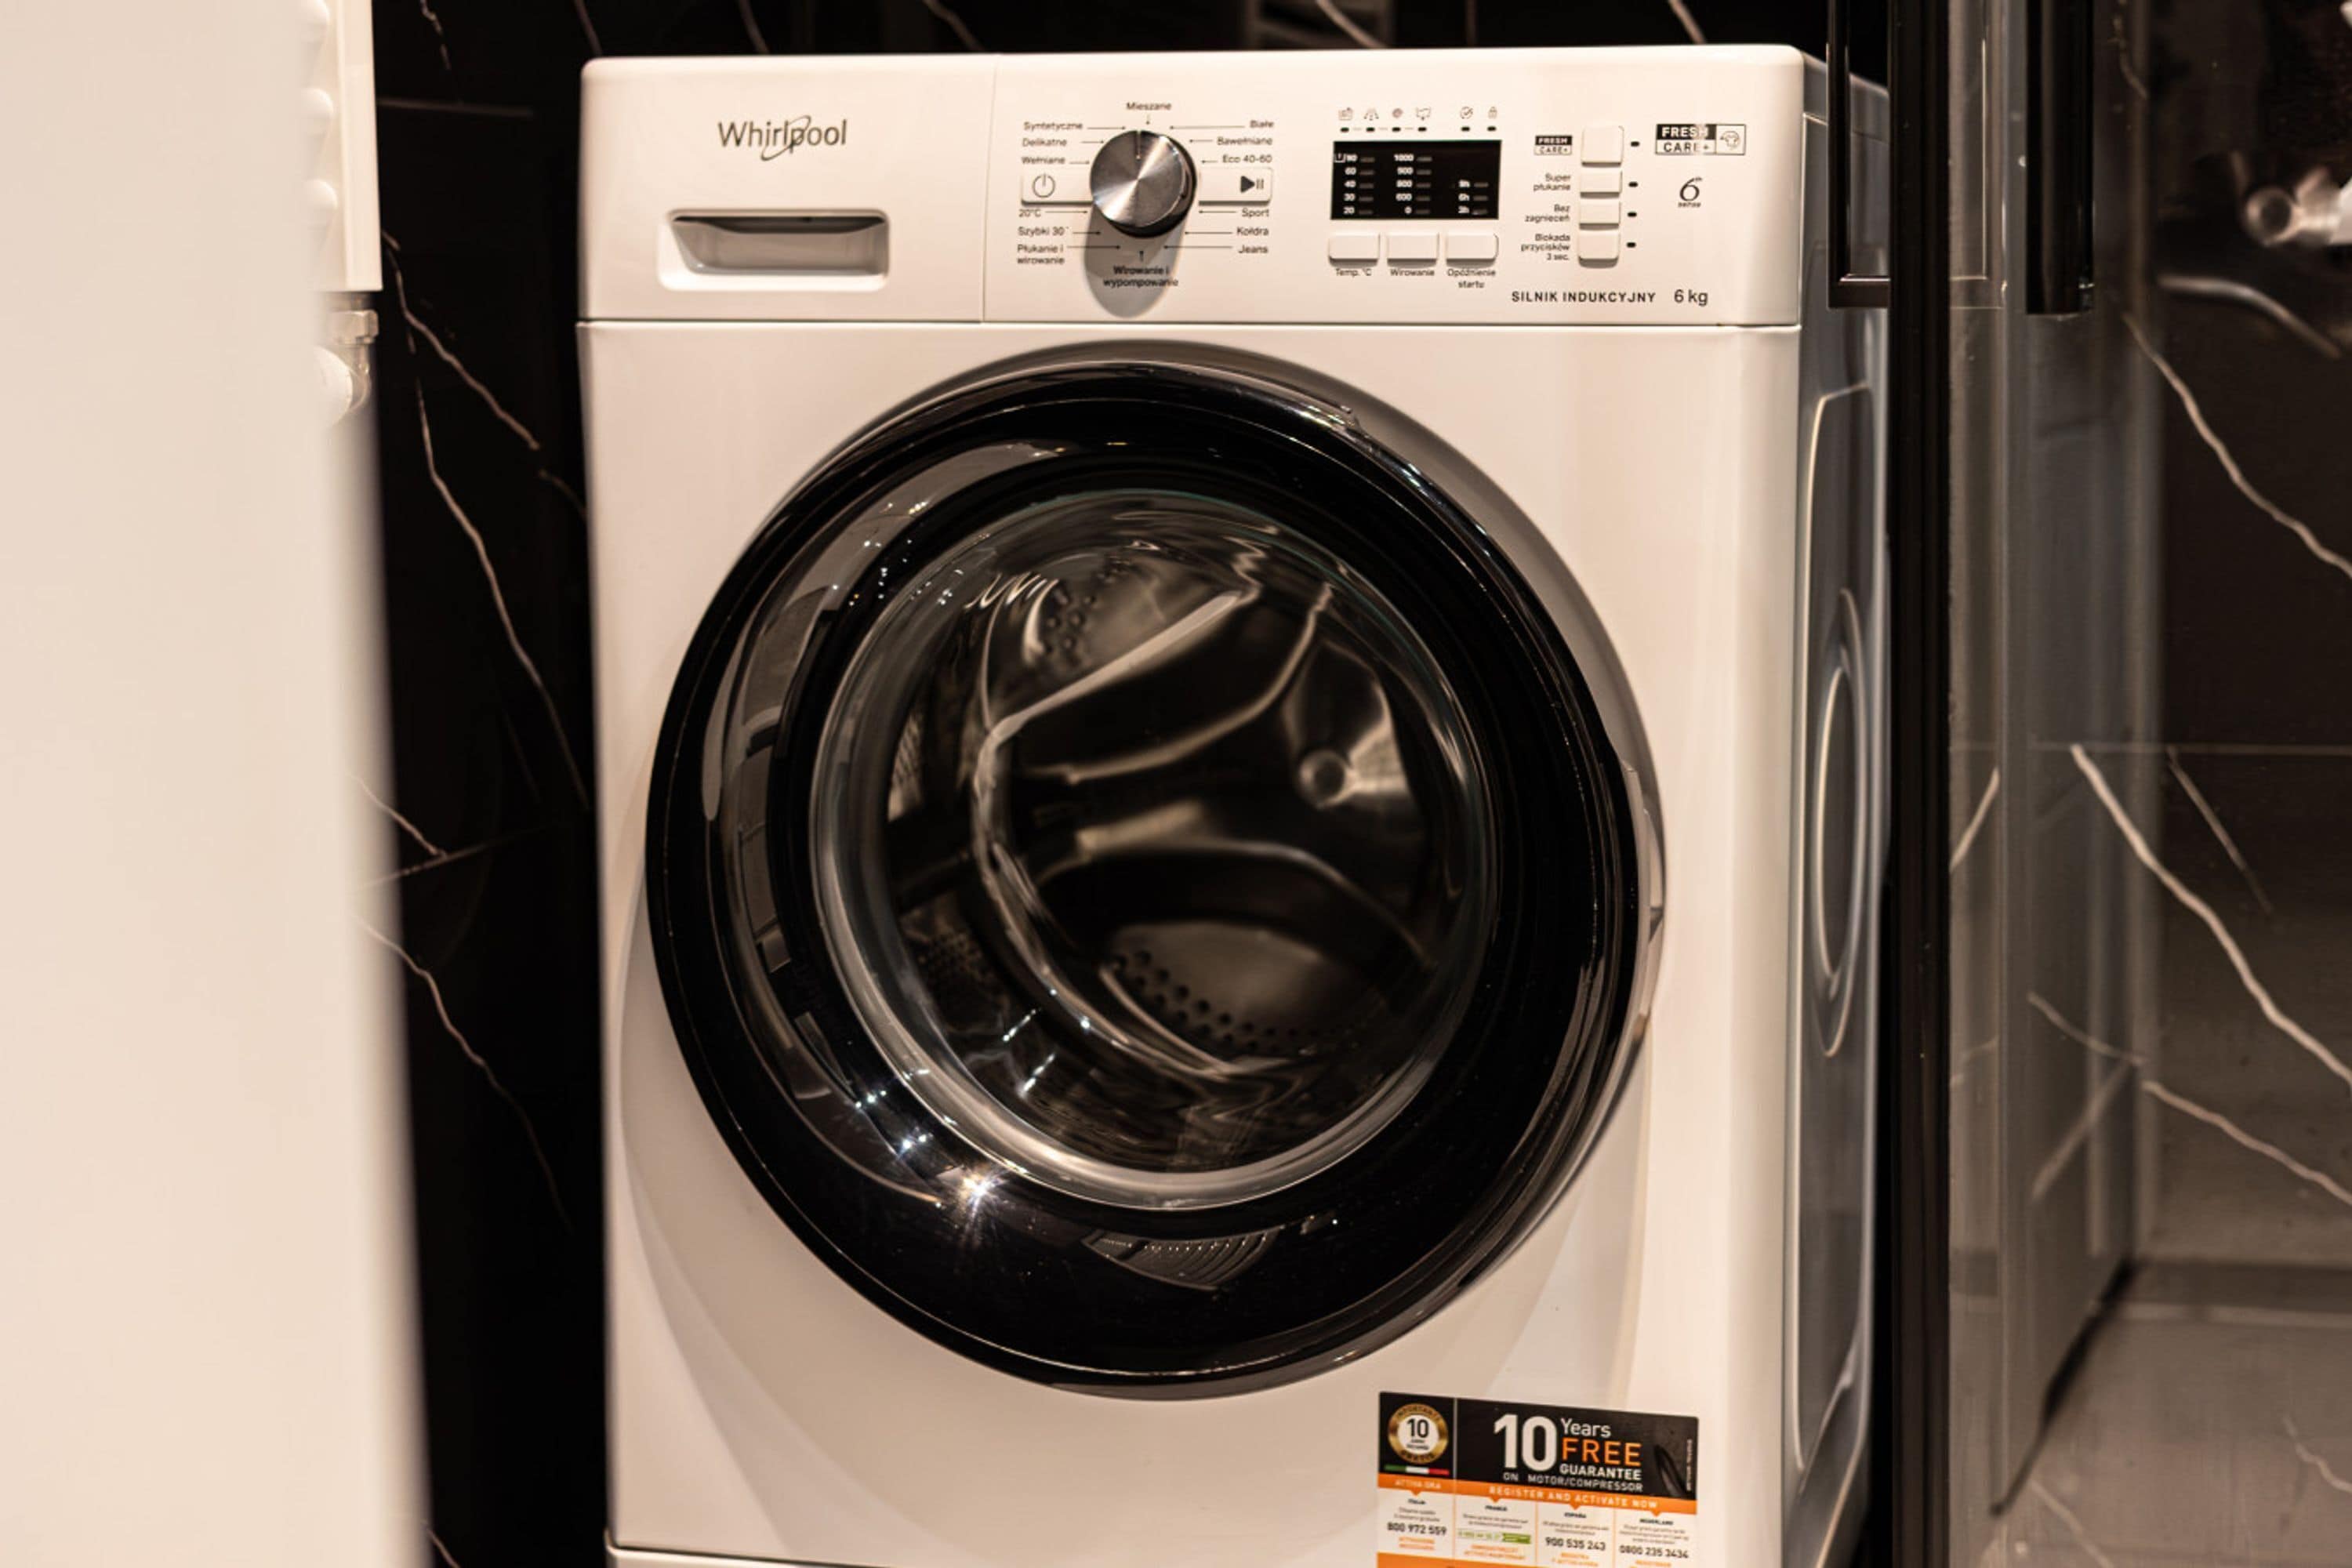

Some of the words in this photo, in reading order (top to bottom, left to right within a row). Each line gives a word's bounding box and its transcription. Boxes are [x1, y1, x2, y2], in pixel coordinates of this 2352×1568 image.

[1127, 101, 1171, 111] Mieszane
[1024, 122, 1083, 132] Syntetyczne
[1661, 125, 1709, 138] FRESH
[718, 115, 848, 162] Whirlpool
[1022, 137, 1067, 147] Delikatne
[1538, 137, 1569, 146] FRESH
[1222, 154, 1240, 163] Eco
[1243, 154, 1272, 163] 40-60
[1544, 173, 1571, 183] Super
[1242, 208, 1269, 219] Sport
[1018, 226, 1049, 237] Szybki
[1239, 245, 1269, 254] Jeans
[1018, 256, 1065, 264] wirowanie
[1113, 265, 1164, 275] Wirowanie
[1103, 278, 1178, 289] wypompowanie
[1512, 292, 1557, 303] SILNIK
[1563, 292, 1656, 303] INDUKCYJNY
[1674, 291, 1684, 303] 6
[1688, 289, 1708, 306] kg
[1407, 1418, 1429, 1438] 10
[1560, 1417, 1612, 1439] Years
[1494, 1414, 1558, 1472] 10
[1561, 1437, 1642, 1467] FREE
[1559, 1463, 1642, 1481] GUARANTEE
[1503, 1472, 1519, 1482] ON
[1528, 1474, 1643, 1492] MOTOR/COMPRESSOR
[1490, 1486, 1544, 1498] REGISTER
[1548, 1491, 1571, 1501] AND
[1574, 1494, 1628, 1507] ACTIVATE
[1632, 1499, 1658, 1509] NOW
[1407, 1524, 1426, 1534] 972
[1545, 1536, 1563, 1547] 900
[1566, 1537, 1584, 1549] 535
[1587, 1540, 1606, 1552] 243
